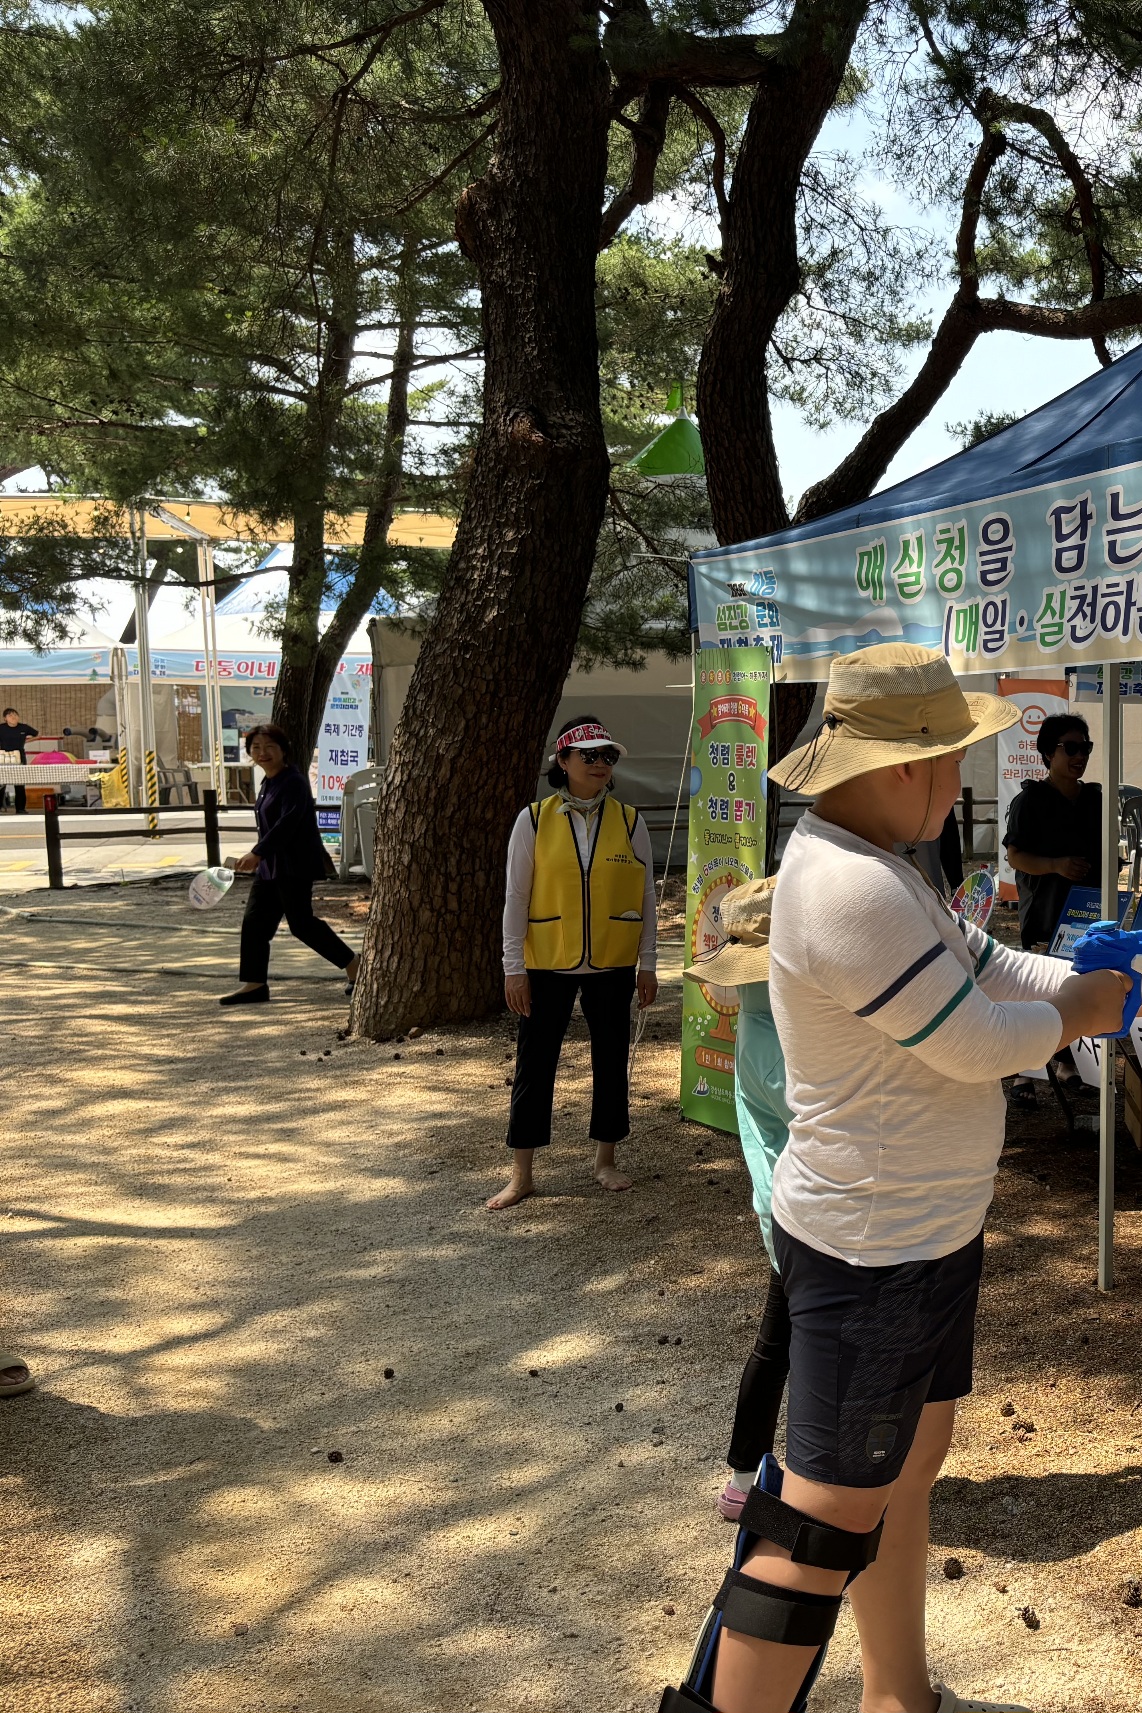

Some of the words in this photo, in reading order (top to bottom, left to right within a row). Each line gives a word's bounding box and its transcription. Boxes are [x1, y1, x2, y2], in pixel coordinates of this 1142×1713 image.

[856, 517, 1014, 601] 매실청을
[749, 569, 777, 597] 하동
[716, 603, 750, 632] 섬진강
[755, 602, 780, 628] 문화
[193, 659, 277, 677] 다둥이네
[324, 723, 340, 737] 축제
[342, 723, 365, 738] 기간중
[328, 748, 359, 766] 재첩국
[709, 742, 731, 766] 청렴
[734, 743, 757, 768] 룰렛
[321, 774, 349, 791] 10%
[727, 772, 737, 792] &
[708, 796, 730, 820] 청렴
[733, 799, 756, 822] 뽑기
[712, 905, 722, 923] 정
